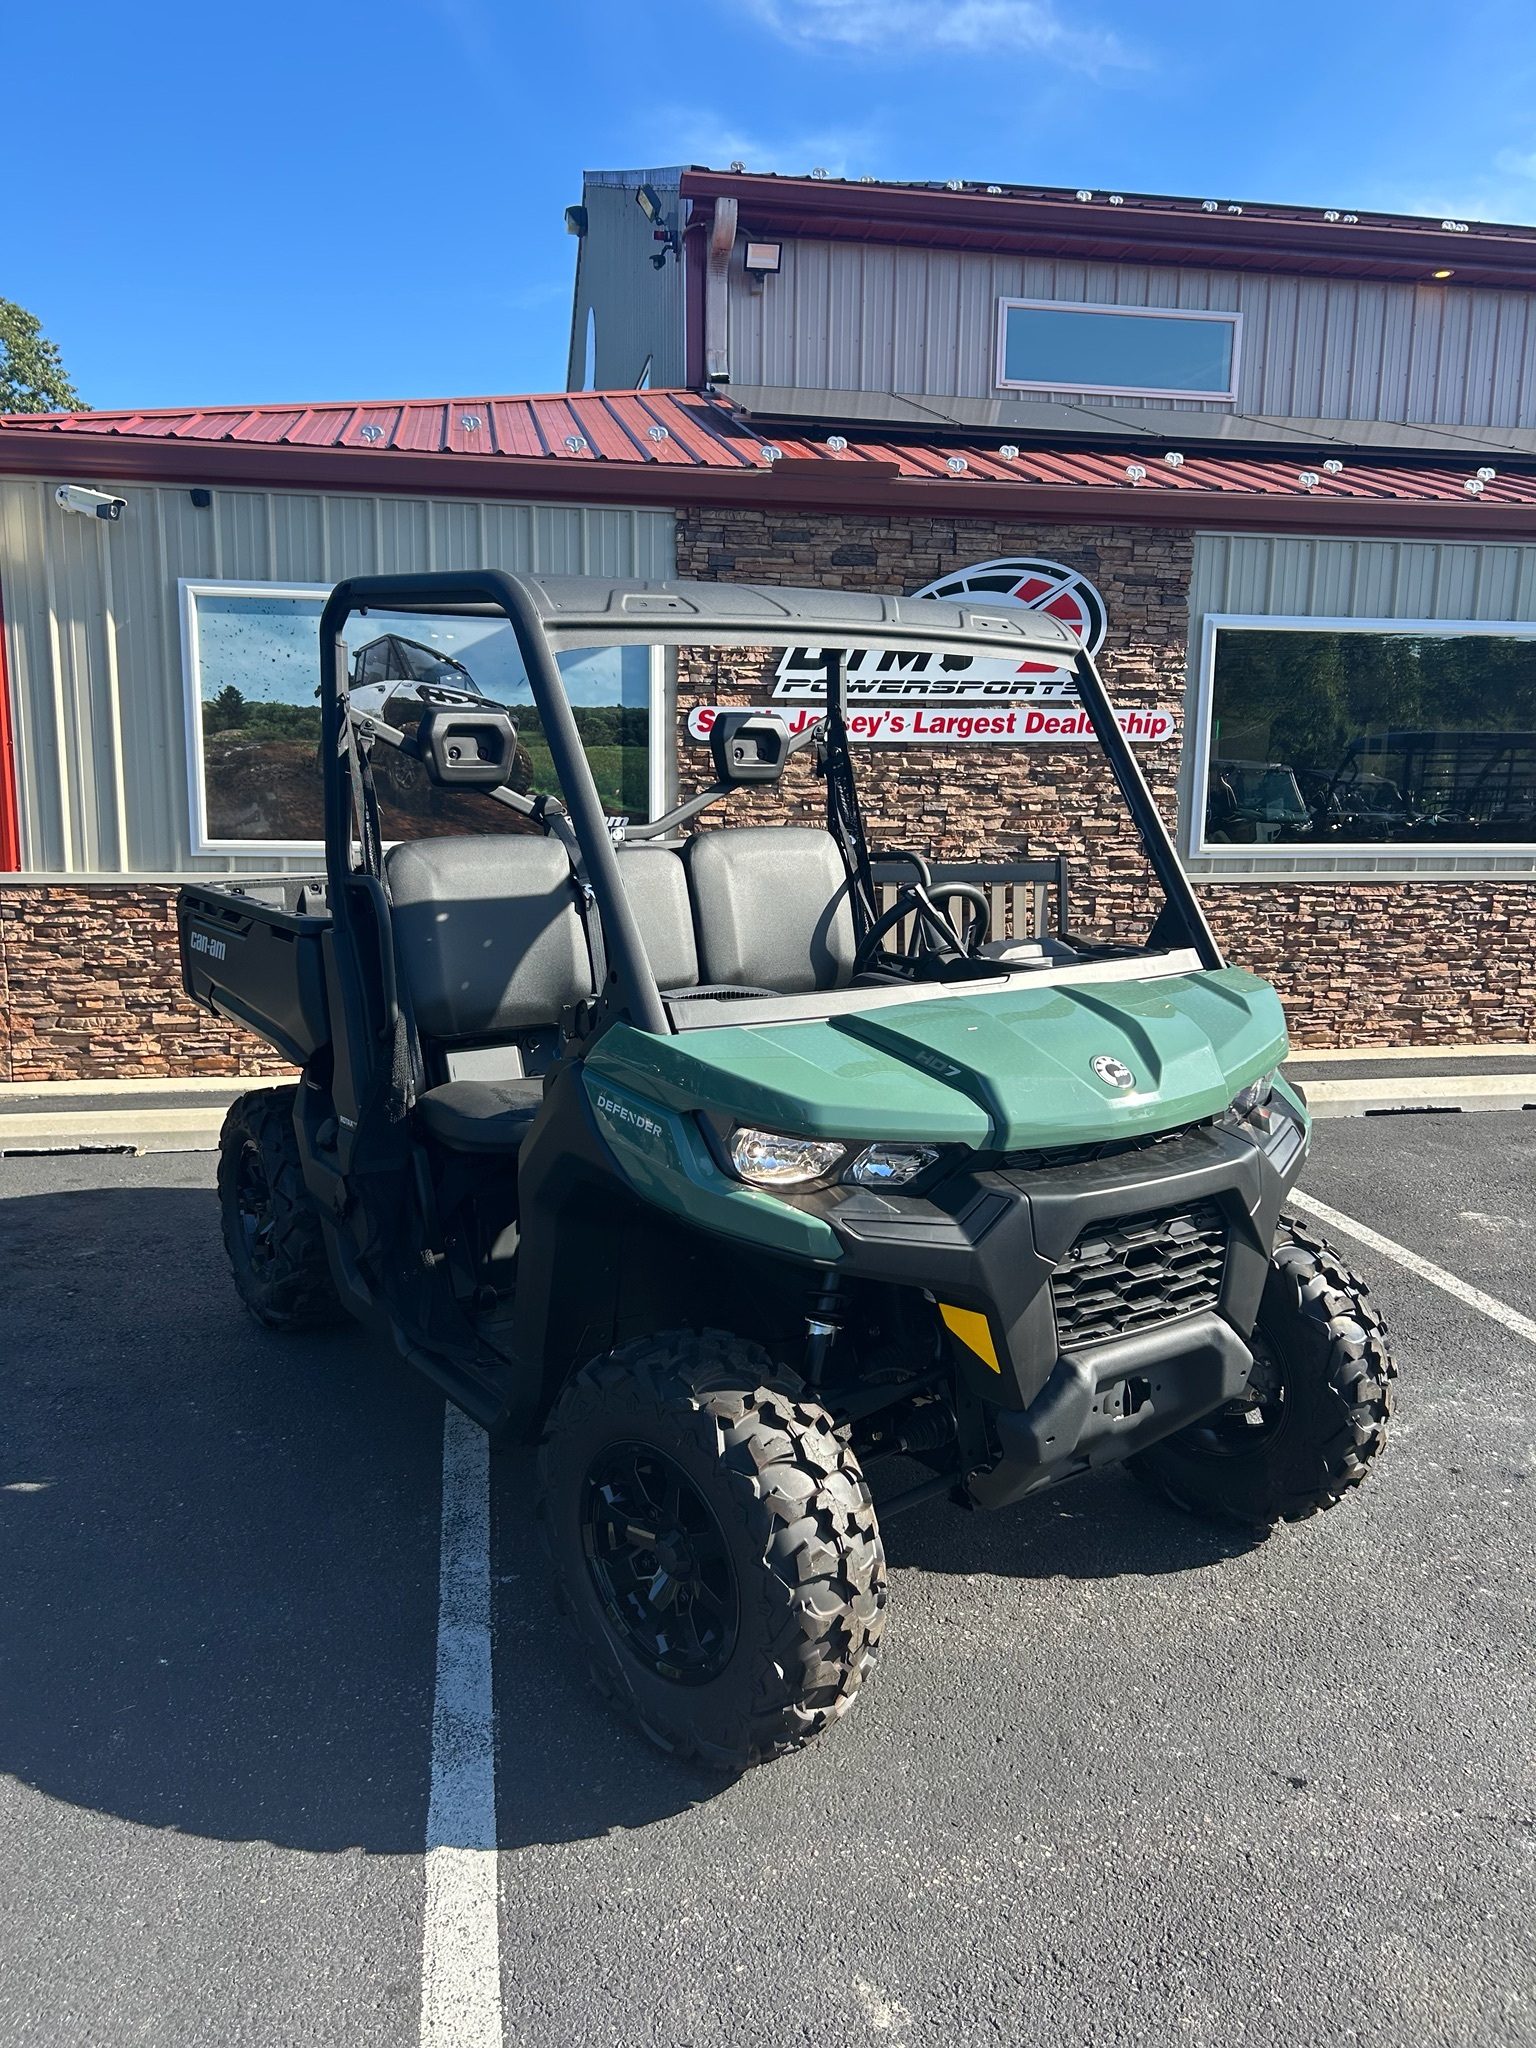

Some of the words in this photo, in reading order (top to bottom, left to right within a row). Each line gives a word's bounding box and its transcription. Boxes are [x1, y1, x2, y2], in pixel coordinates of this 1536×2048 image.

[782, 679, 1080, 695] POWERSPORTS
[789, 711, 905, 738] Jeey's
[913, 712, 1017, 739] Largest
[1025, 712, 1167, 738] Dealeship
[191, 931, 226, 960] can-am
[914, 1050, 962, 1077] HD7
[597, 1095, 662, 1138] DEFENDER
